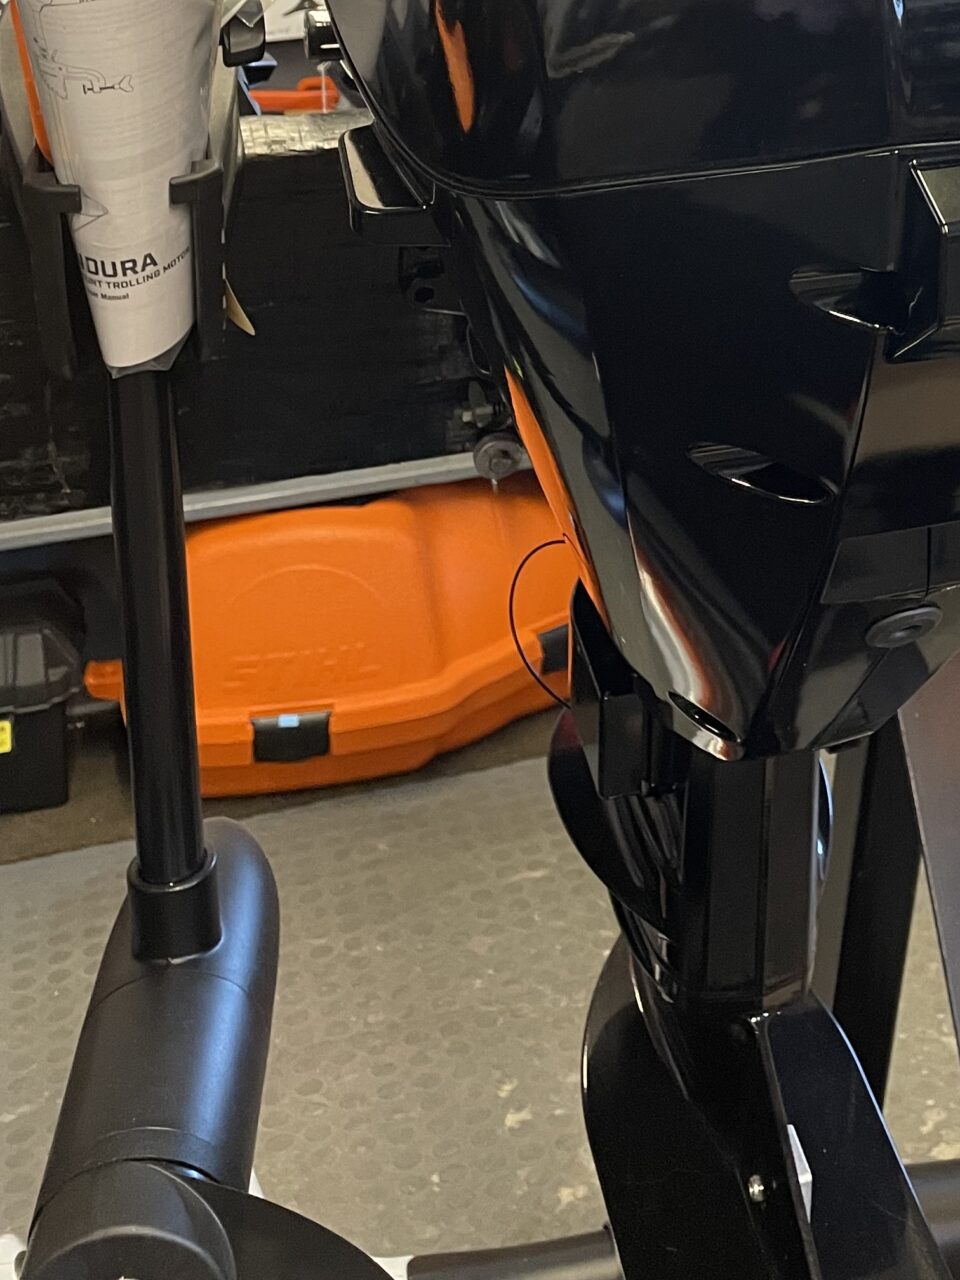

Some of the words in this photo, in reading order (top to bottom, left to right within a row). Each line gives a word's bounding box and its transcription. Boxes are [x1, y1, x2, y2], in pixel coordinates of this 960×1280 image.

[78, 252, 159, 278] DURA
[105, 269, 160, 289] TROLLING
[100, 292, 129, 300] Manual
